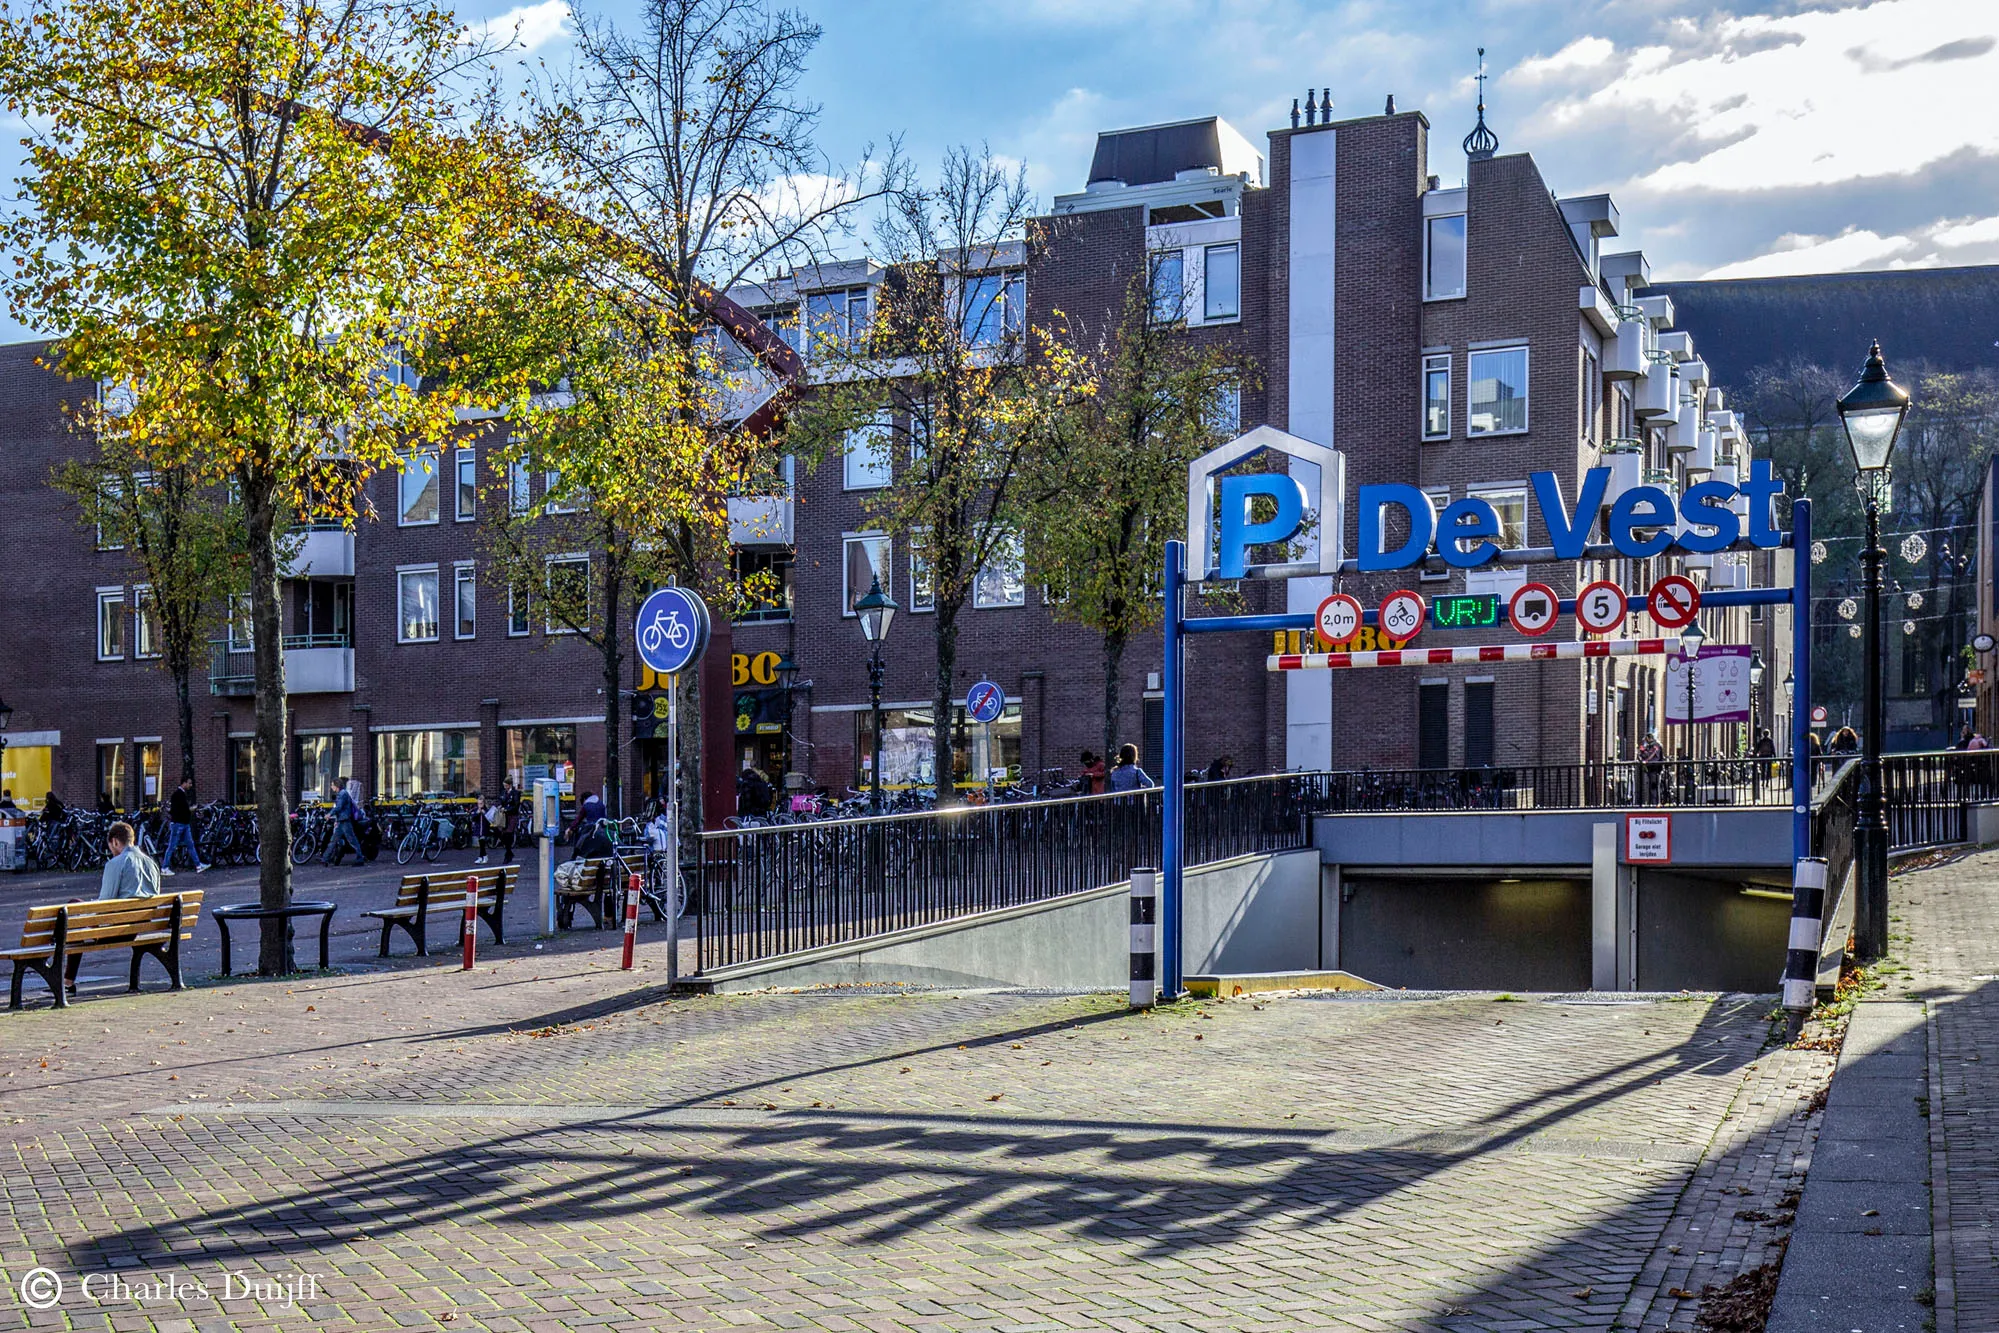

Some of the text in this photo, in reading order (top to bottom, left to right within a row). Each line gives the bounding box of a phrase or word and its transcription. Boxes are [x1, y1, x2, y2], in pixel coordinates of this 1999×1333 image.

[1220, 459, 1785, 579] P De Vest
[1593, 595, 1610, 619] 5
